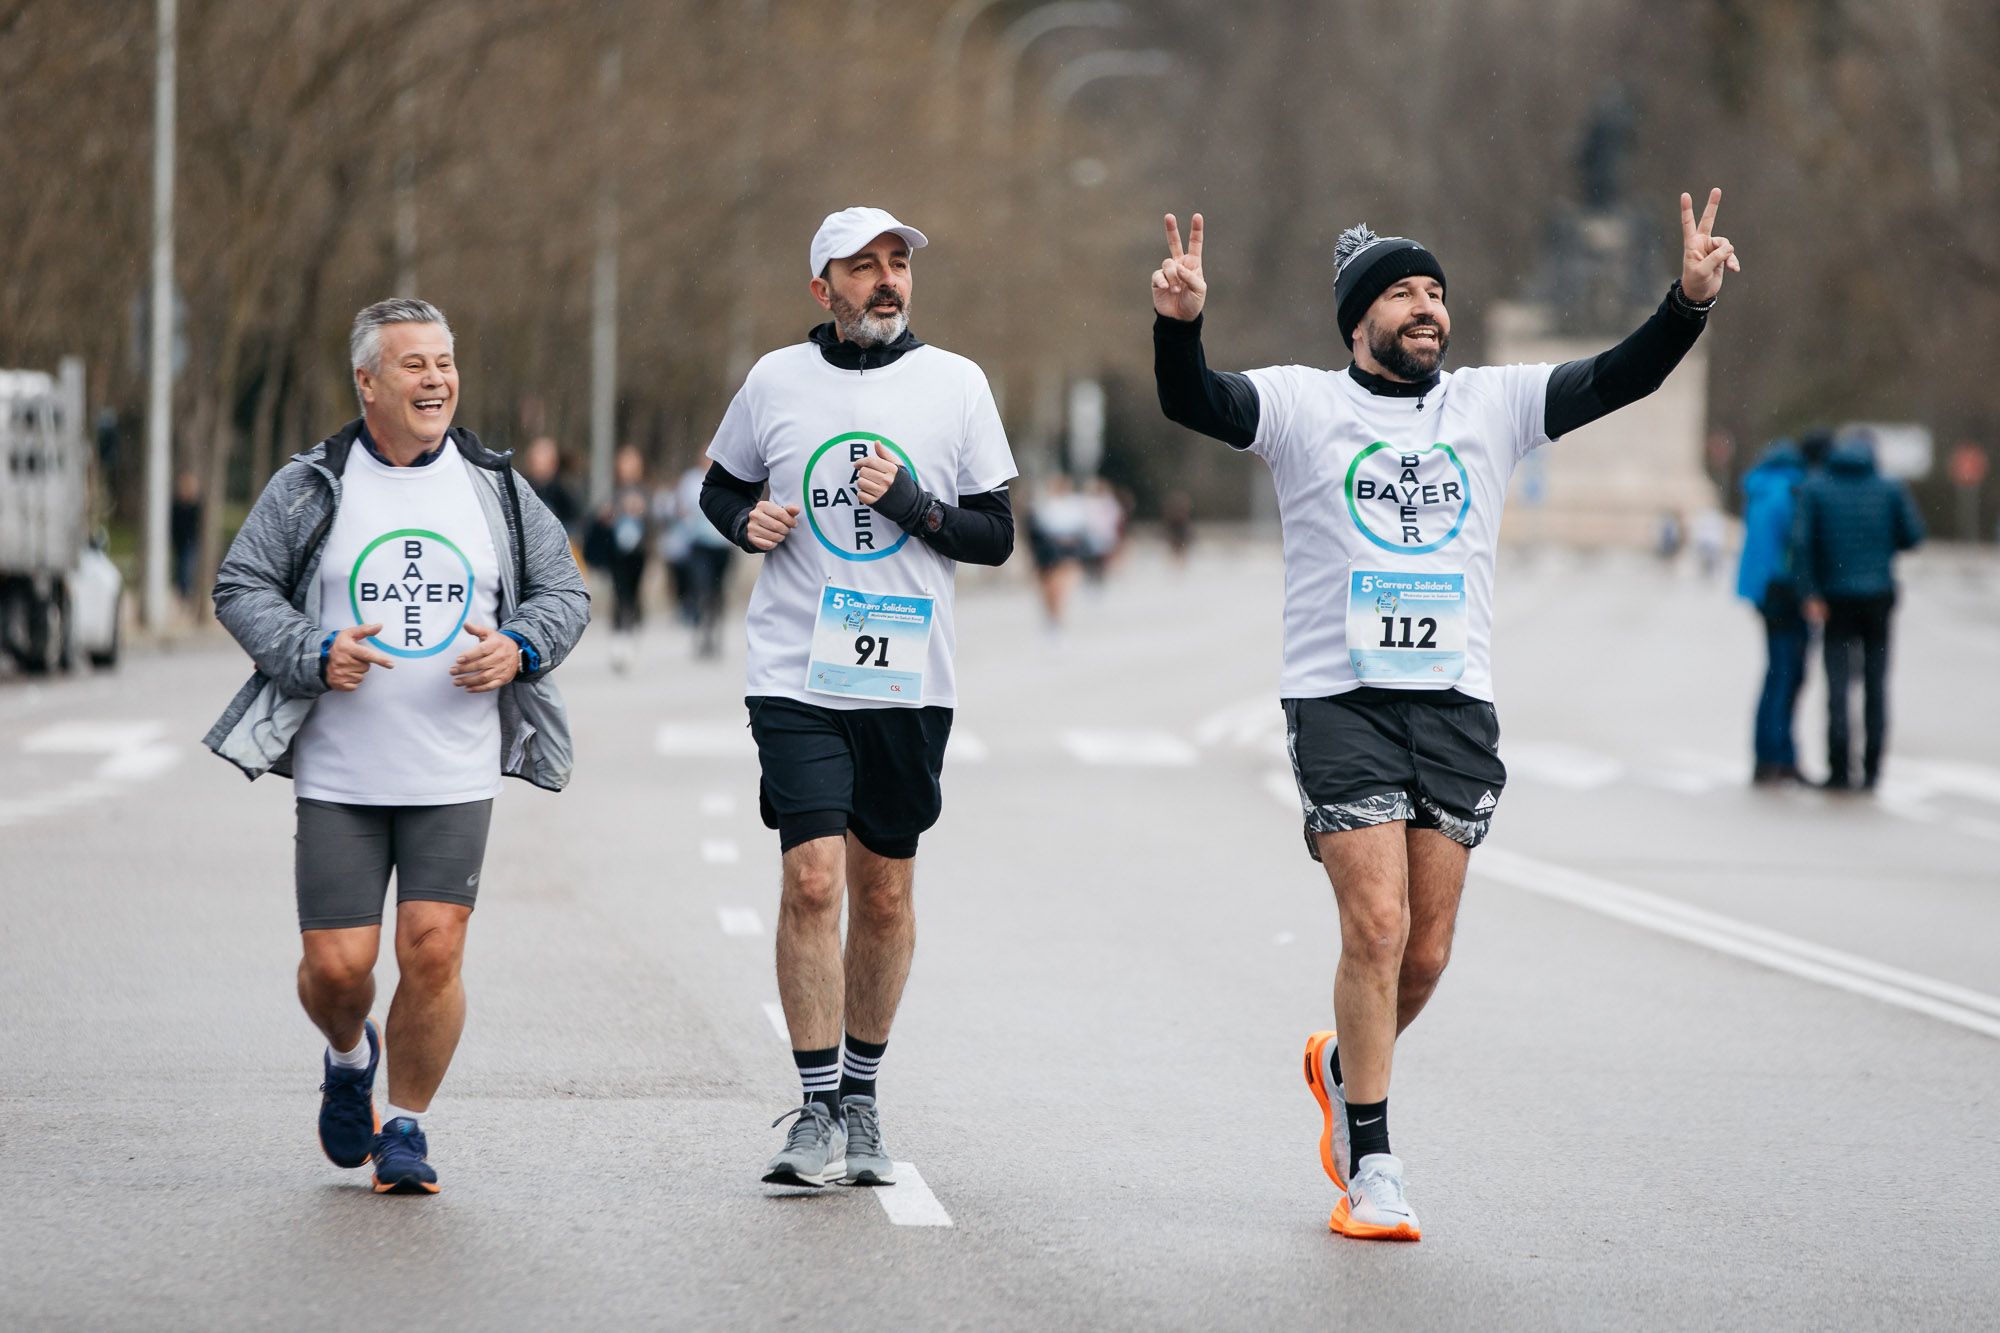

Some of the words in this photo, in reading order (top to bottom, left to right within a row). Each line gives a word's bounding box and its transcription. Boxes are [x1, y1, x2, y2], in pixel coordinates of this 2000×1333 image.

[812, 487, 866, 508] BAY
[1357, 480, 1462, 505] BAYER
[1398, 453, 1423, 544] BAYER
[360, 582, 464, 603] BAYER
[402, 540, 424, 647] BAYER
[1375, 579, 1412, 589] Carrera
[1414, 580, 1453, 590] Solidaria
[846, 597, 880, 611] Carrera
[882, 602, 917, 613] Solidaria
[1379, 616, 1437, 649] 112
[854, 634, 890, 668] 91
[890, 684, 902, 693] CSL
